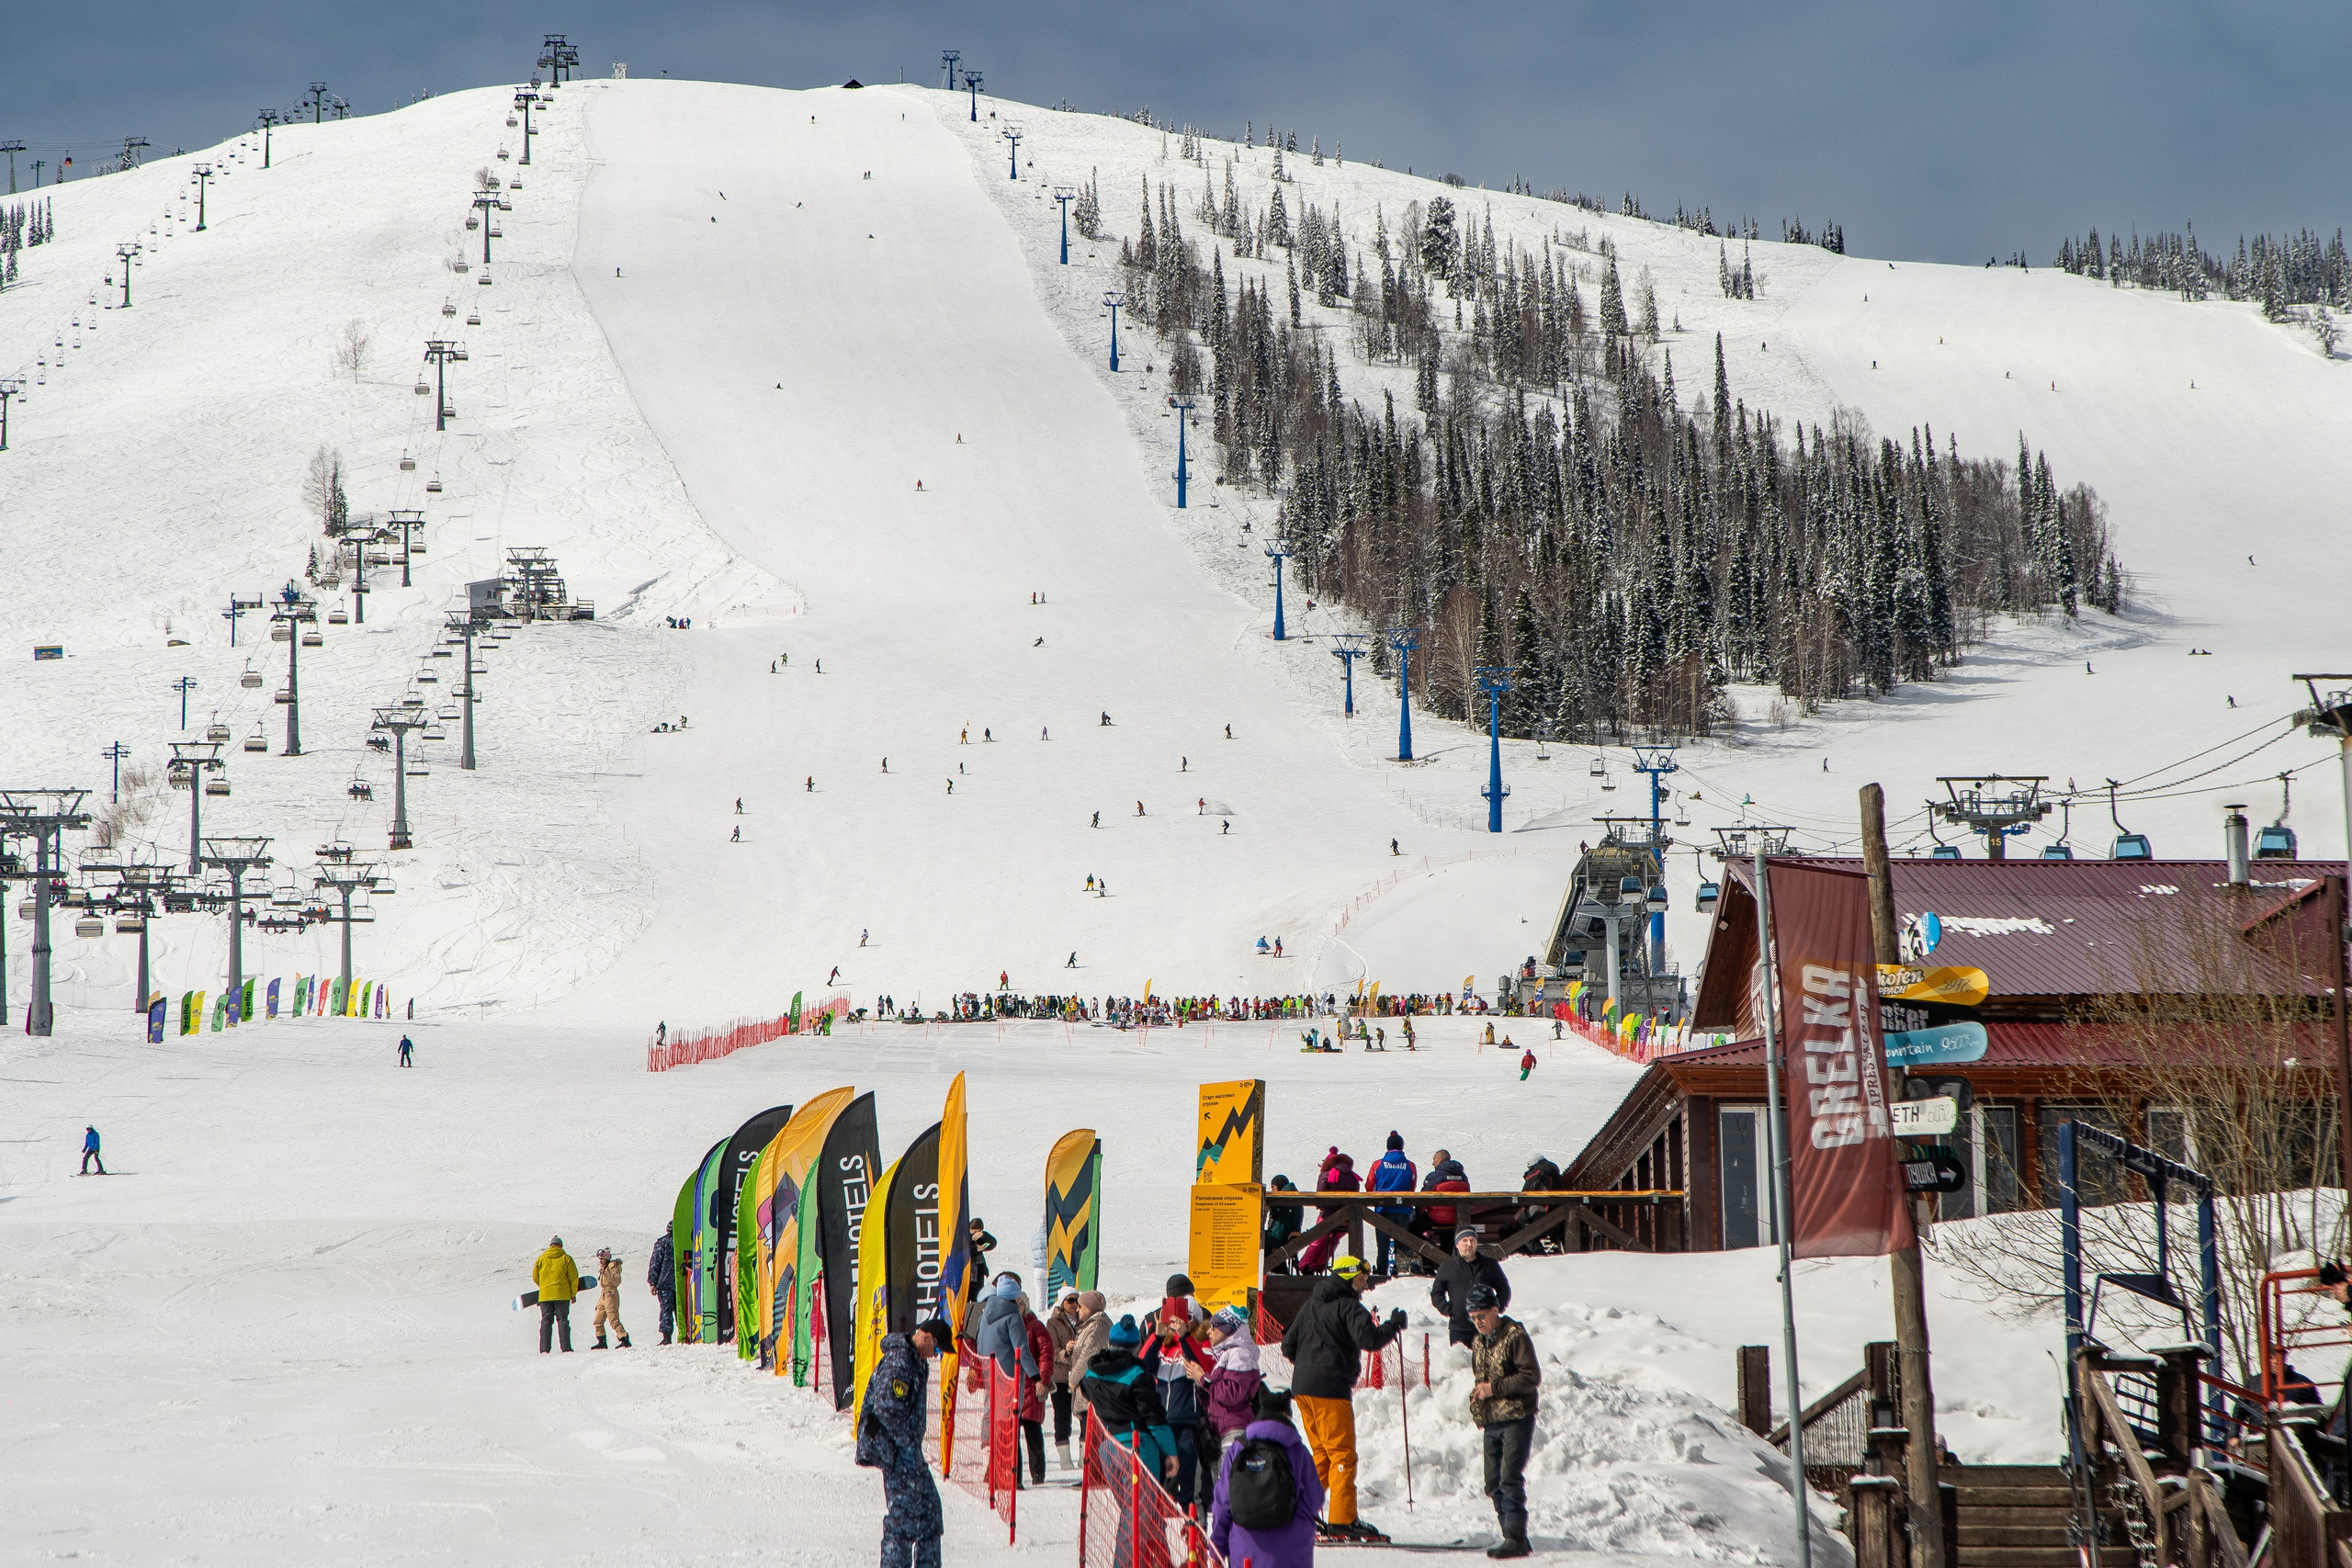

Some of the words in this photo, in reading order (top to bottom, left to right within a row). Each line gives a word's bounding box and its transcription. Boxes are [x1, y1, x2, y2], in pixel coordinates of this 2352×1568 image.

[1990, 838, 2002, 846] 15
[1803, 964, 1865, 1149] GRELKA
[1383, 1161, 1408, 1170] RUSSIA
